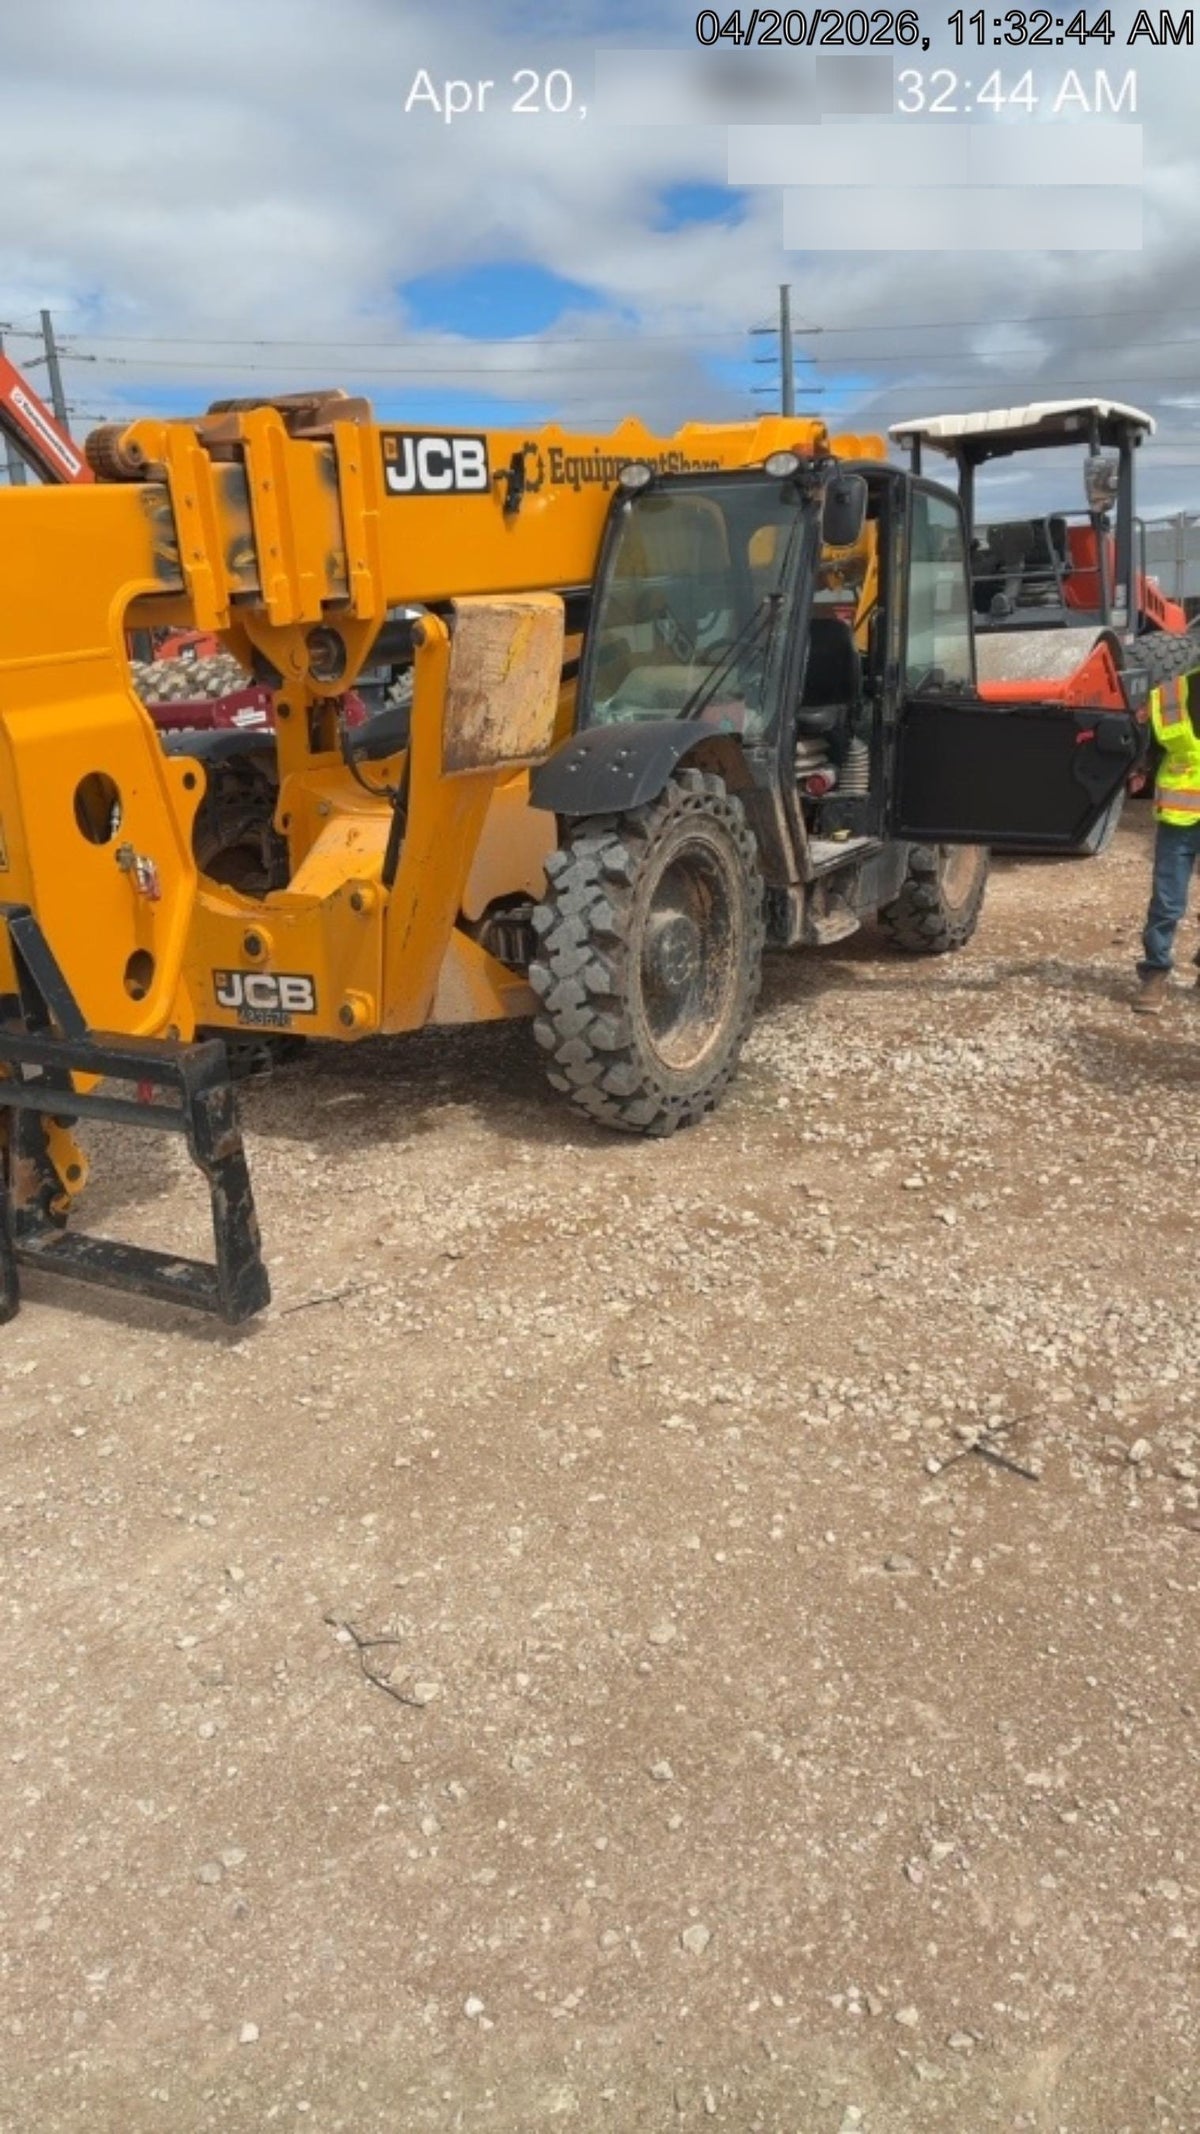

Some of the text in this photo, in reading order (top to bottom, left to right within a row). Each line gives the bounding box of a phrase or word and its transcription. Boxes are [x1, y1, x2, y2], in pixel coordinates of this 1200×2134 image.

[386, 437, 487, 490] JCB
[548, 447, 720, 491] EquipmntSh
[218, 973, 314, 1011] JCB
